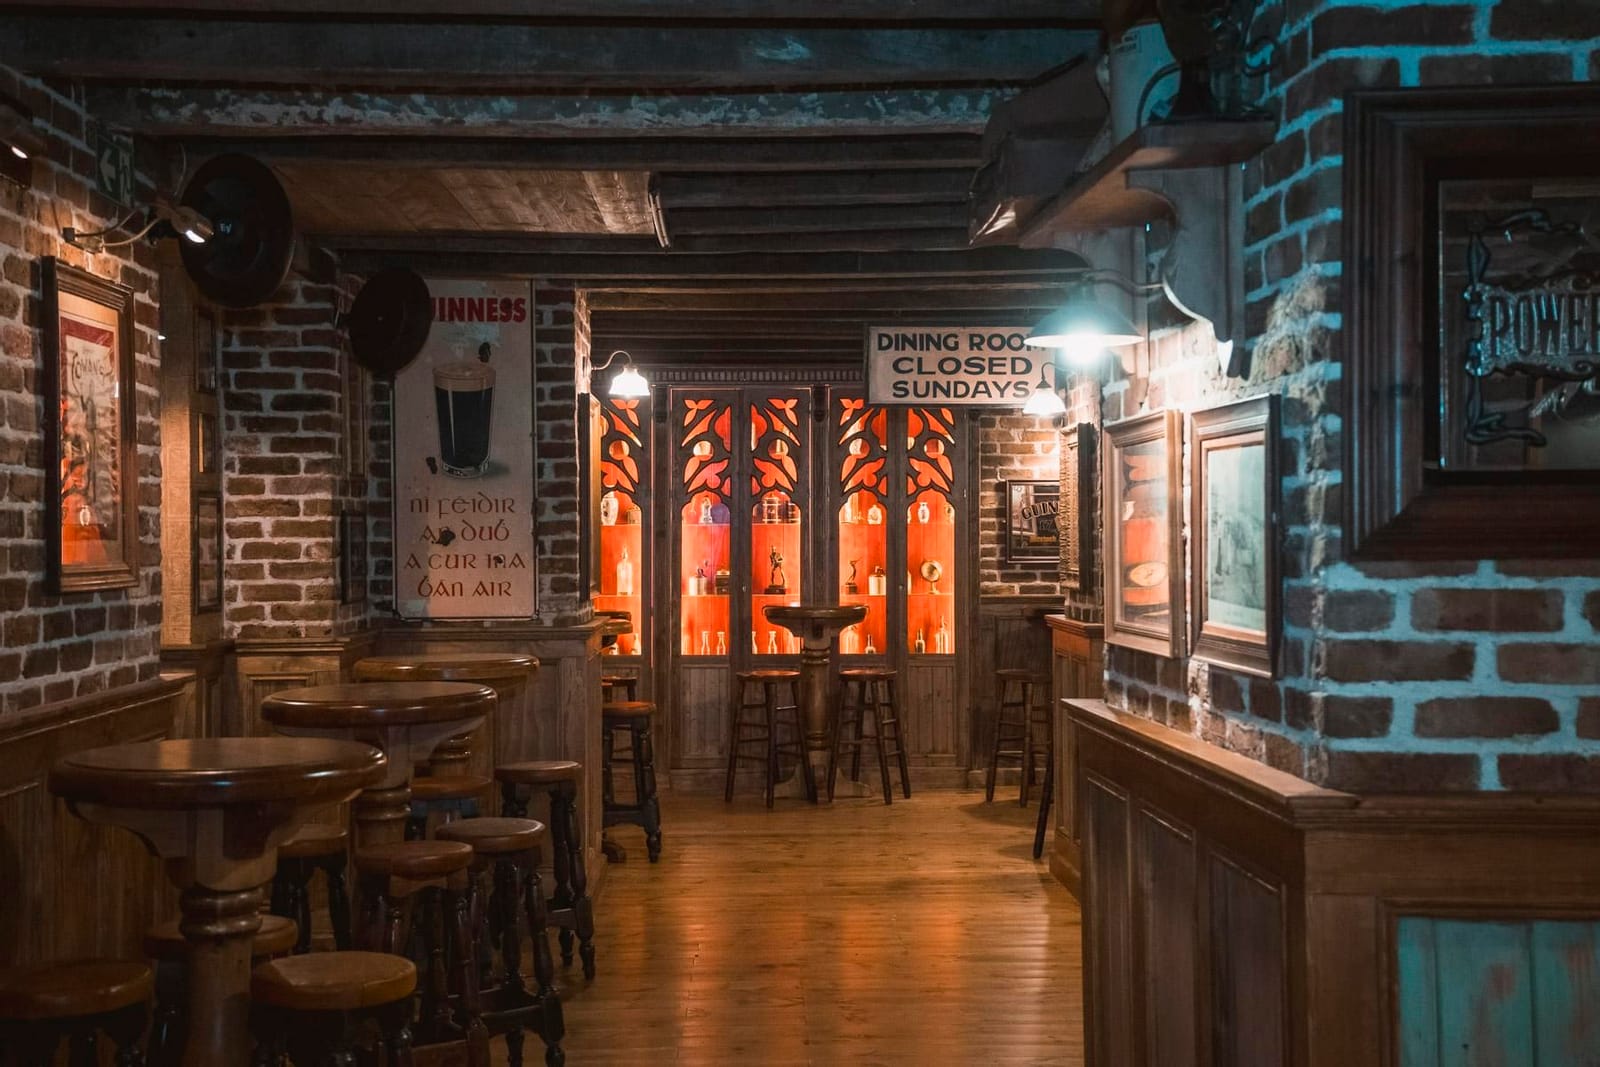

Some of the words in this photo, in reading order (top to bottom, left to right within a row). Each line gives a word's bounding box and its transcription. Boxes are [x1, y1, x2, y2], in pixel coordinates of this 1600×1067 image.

[431, 297, 526, 322] INNESS
[877, 332, 960, 351] DINING
[892, 356, 1033, 376] CLOSED
[892, 380, 1031, 398] SUNDAYS
[472, 580, 512, 597] AIR
